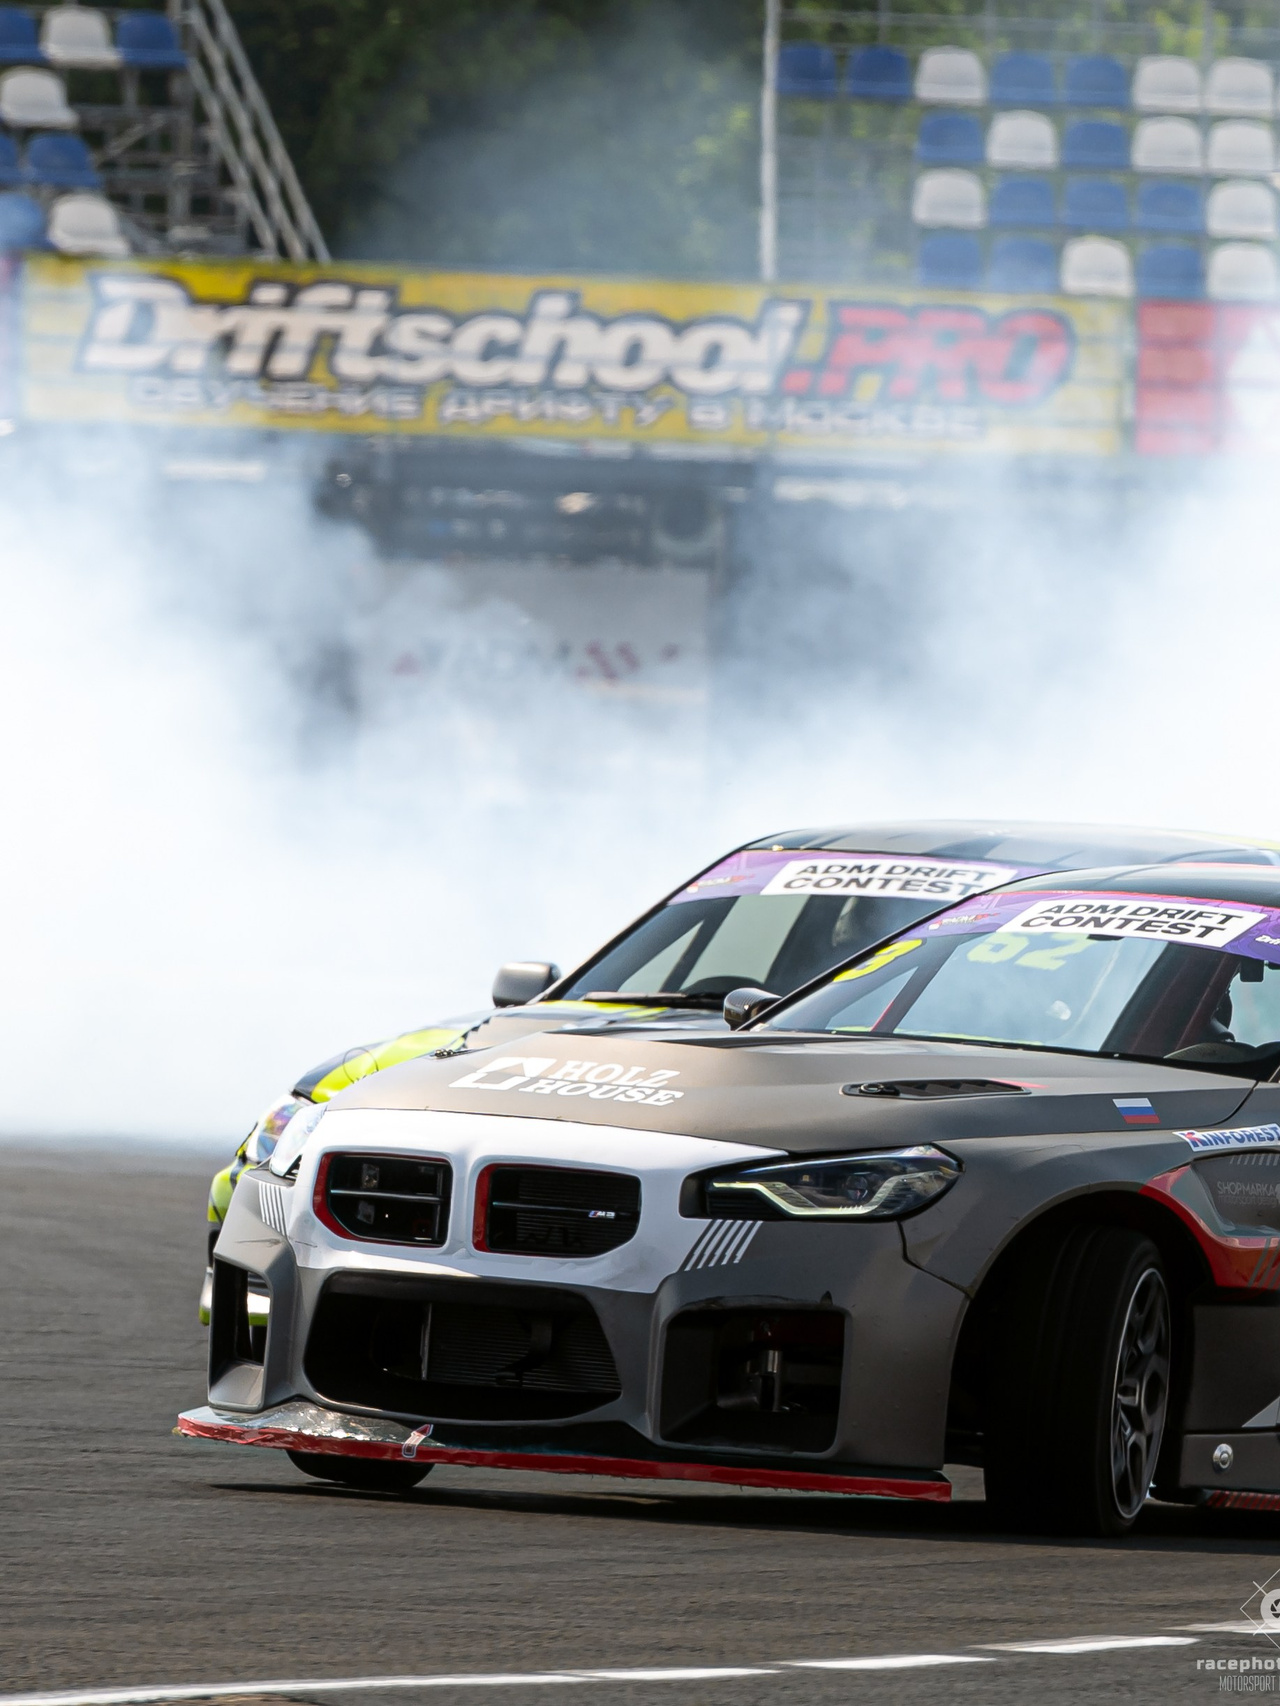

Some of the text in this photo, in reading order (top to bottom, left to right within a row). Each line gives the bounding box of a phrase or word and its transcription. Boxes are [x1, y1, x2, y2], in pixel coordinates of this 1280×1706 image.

[796, 863, 996, 882] ADM DRIFT
[783, 877, 984, 896] CONTEST
[1039, 904, 1244, 925] ADM DRIFT
[1020, 915, 1227, 938] CONTEST
[551, 1060, 681, 1088] HOLZ
[517, 1079, 685, 1107] HOUSE
[1217, 1181, 1276, 1196] SHOPMARKA
